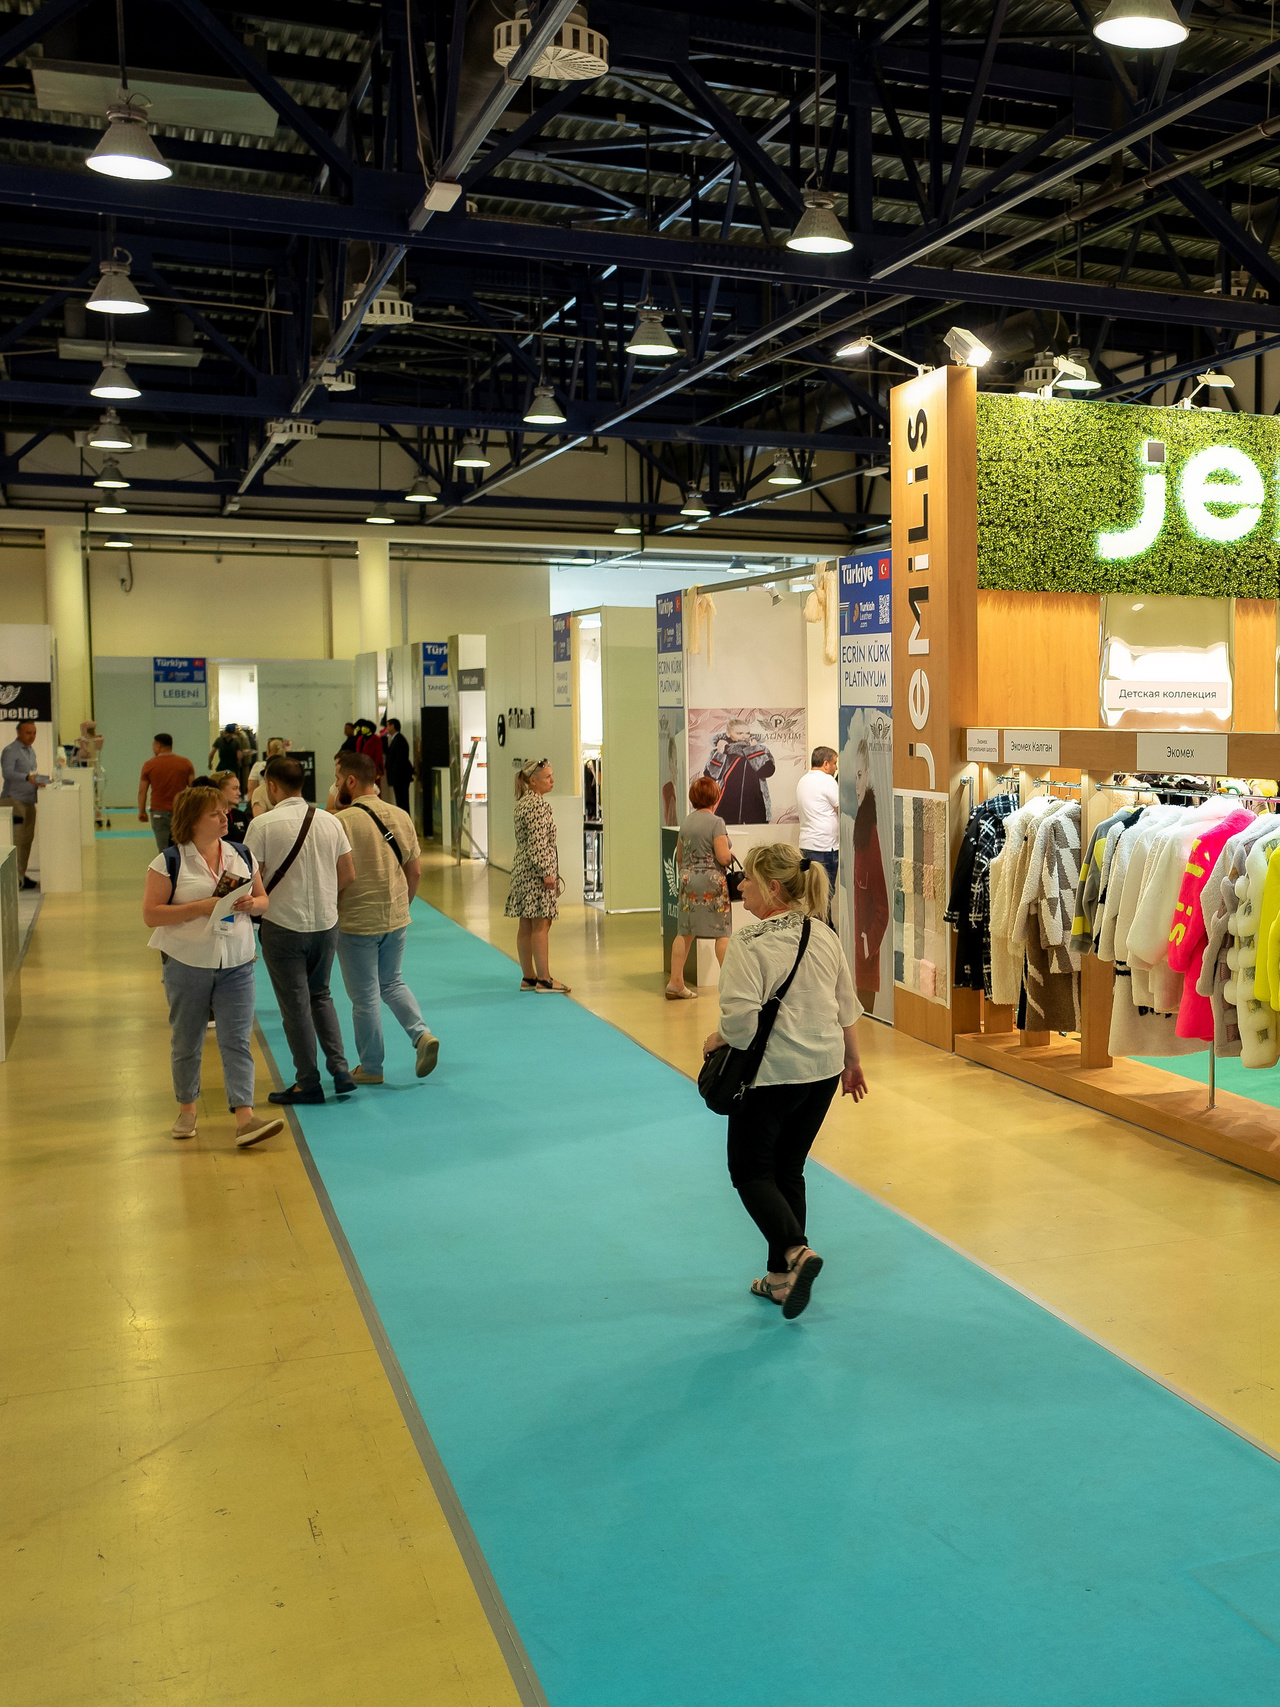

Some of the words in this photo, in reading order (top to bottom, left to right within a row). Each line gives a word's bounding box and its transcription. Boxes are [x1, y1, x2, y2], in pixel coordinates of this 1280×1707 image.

[841, 562, 873, 587] Türkiye
[860, 601, 875, 612] Turkish
[842, 641, 865, 663] ECRİN
[868, 640, 890, 662] KÜRK
[844, 667, 887, 688] PLATİNYUM
[1119, 689, 1160, 699] Детская
[1163, 690, 1217, 699] коллекция
[1010, 740, 1031, 752] Экомех
[1032, 741, 1053, 752] Калган
[1166, 746, 1195, 758] Экомех
